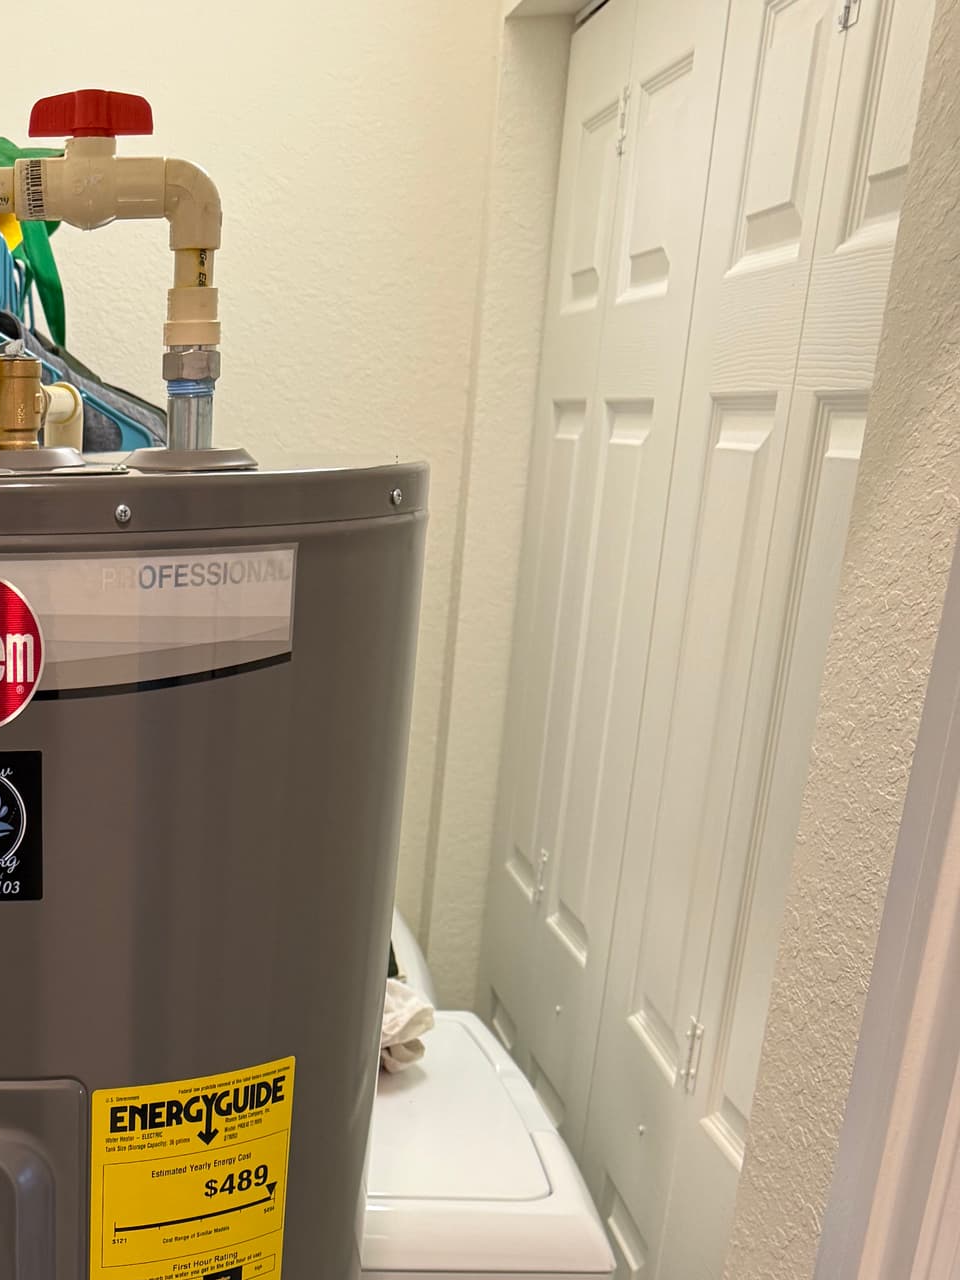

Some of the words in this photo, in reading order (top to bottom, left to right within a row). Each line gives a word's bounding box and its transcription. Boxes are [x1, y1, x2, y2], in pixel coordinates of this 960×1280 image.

[102, 557, 291, 590] PROFESSIONAL
[110, 1075, 286, 1134] ENERGYGUIDE
[151, 1166, 188, 1179] Estimated
[190, 1162, 211, 1173] Yearly
[214, 1156, 237, 1168] Energy
[238, 1152, 252, 1162] Cost
[204, 1164, 269, 1198] $489
[172, 1262, 191, 1272] First
[193, 1258, 212, 1268] Hour
[214, 1251, 238, 1264] Rating
